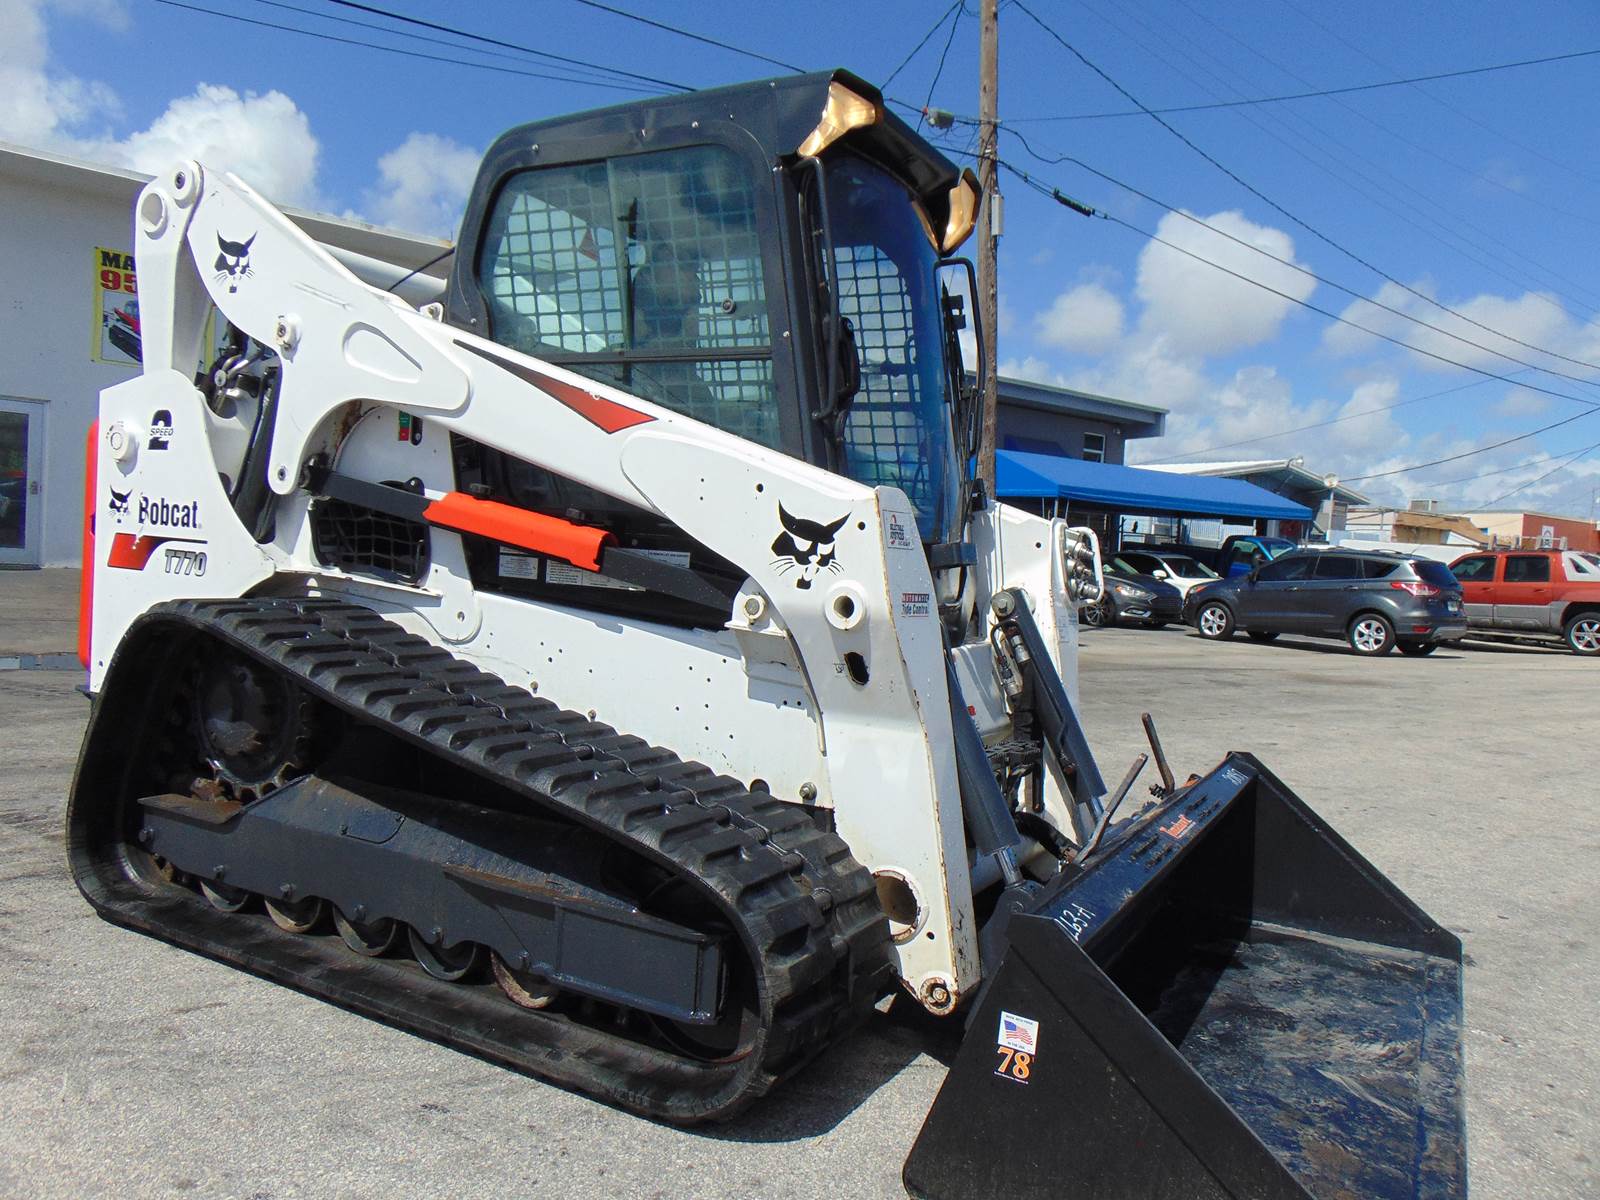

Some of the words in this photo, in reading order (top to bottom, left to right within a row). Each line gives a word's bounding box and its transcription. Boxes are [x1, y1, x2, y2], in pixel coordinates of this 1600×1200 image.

[148, 409, 172, 450] 2
[150, 427, 173, 436] SPEED
[138, 497, 199, 529] Bobcat
[164, 549, 207, 577] T770
[997, 1046, 1031, 1079] 78
